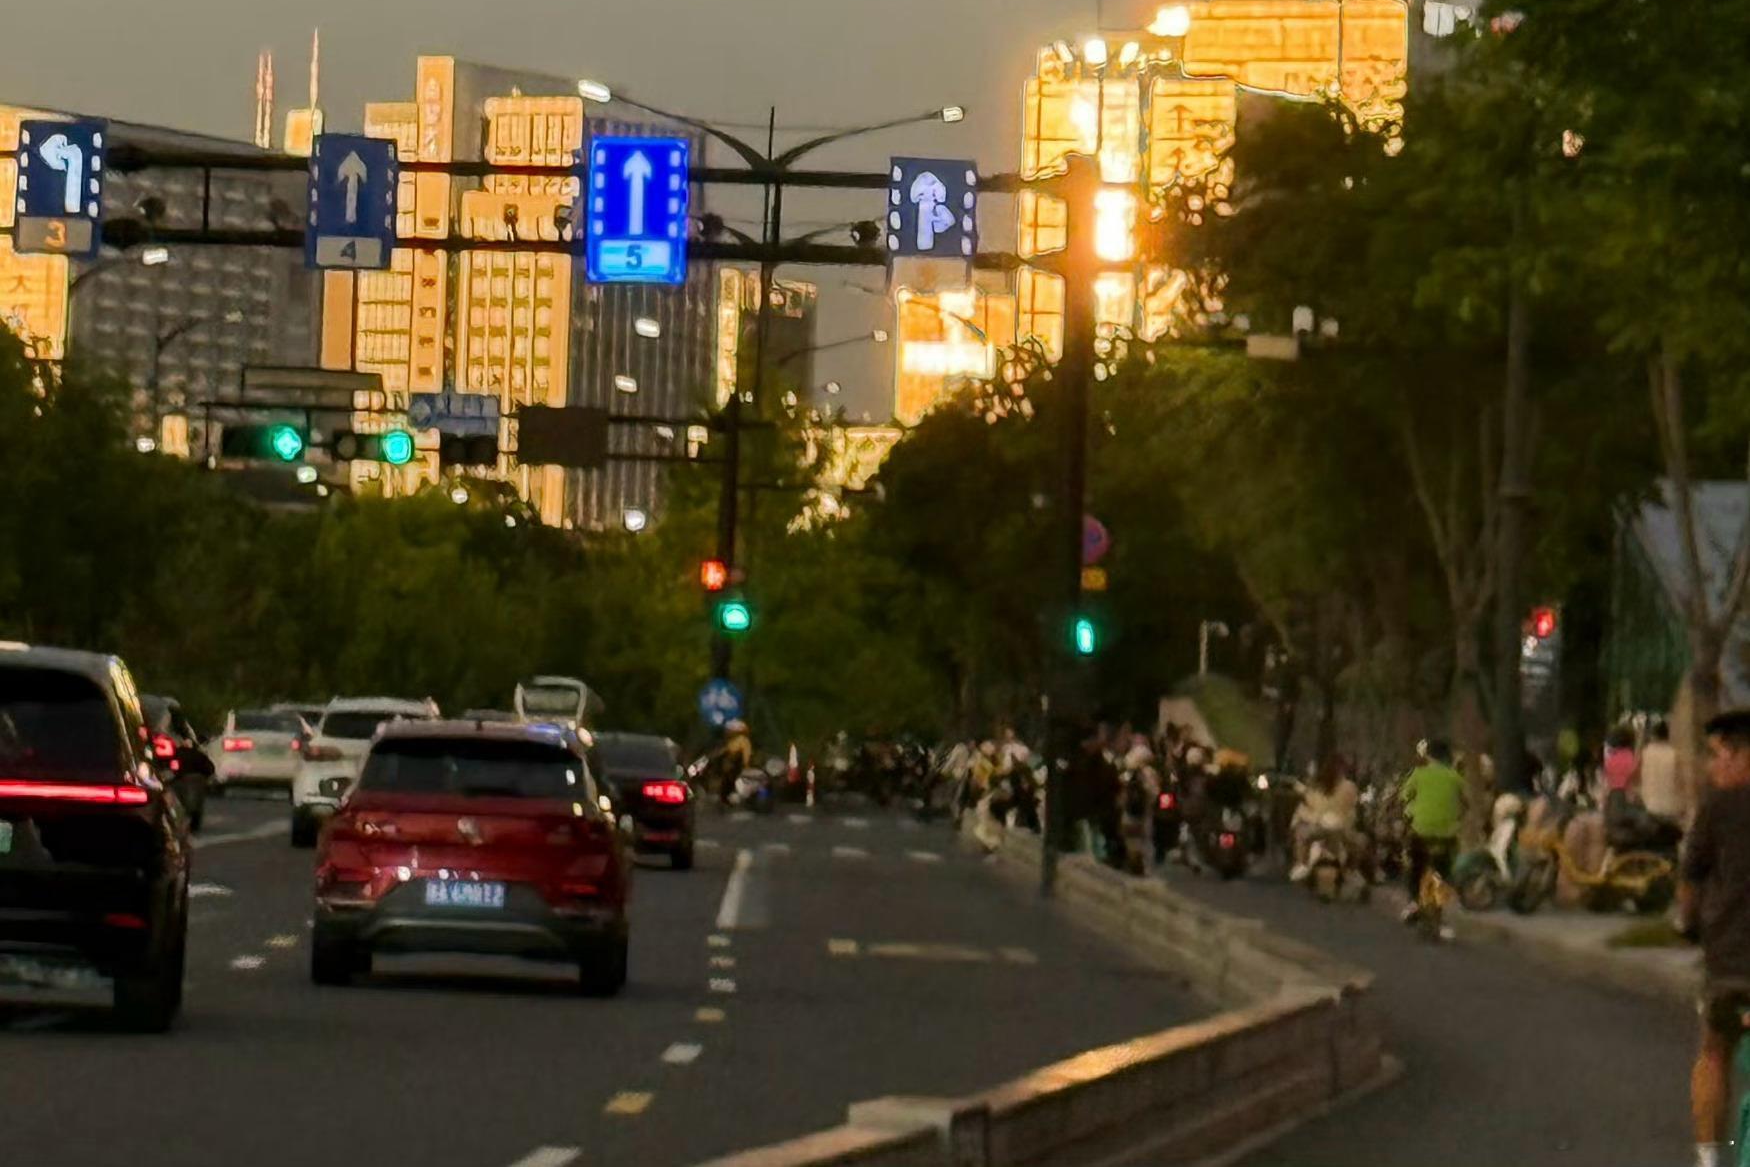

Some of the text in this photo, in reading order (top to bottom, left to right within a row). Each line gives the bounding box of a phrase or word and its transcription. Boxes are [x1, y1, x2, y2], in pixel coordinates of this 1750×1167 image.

[45, 220, 66, 247] 3
[340, 239, 356, 262] 4
[626, 244, 642, 270] 5
